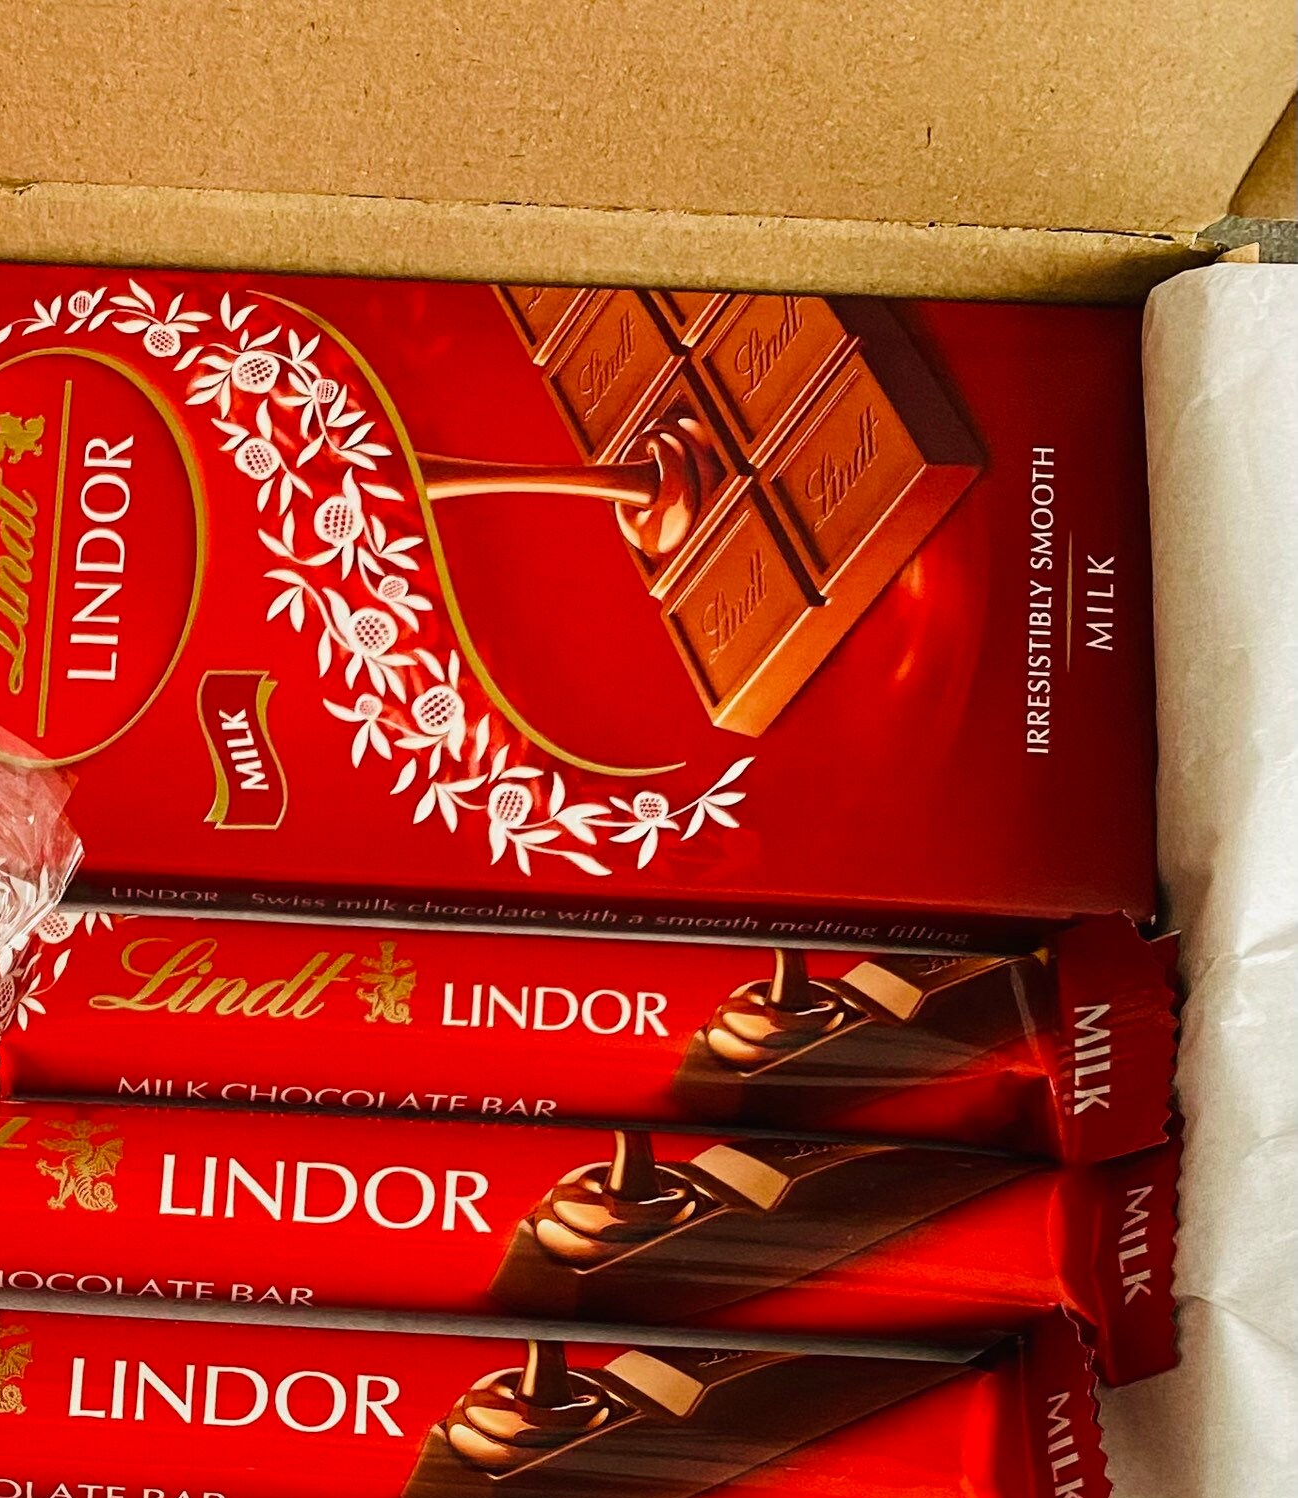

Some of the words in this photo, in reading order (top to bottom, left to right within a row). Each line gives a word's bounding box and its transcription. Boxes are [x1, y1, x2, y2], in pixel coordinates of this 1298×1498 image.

[804, 406, 880, 530] Lindt
[1030, 447, 1055, 570] SMOOTH
[67, 435, 135, 681] LINDOR
[703, 548, 769, 665] Lindt
[1086, 553, 1116, 651] MILK
[1027, 581, 1052, 754] IRRESISTIBLY
[221, 707, 270, 792] MILK
[112, 886, 218, 902] LINDOR
[251, 892, 326, 908] Swiss
[336, 893, 399, 912] milk
[407, 900, 546, 920] chocolate
[556, 908, 617, 924] with
[627, 914, 643, 925] a
[654, 915, 759, 932] smooth
[768, 919, 878, 940] melting
[886, 924, 972, 945] filling
[89, 937, 355, 1020] Lindt
[441, 982, 670, 1038] LINDOR
[117, 1076, 210, 1100] MILK
[481, 1096, 558, 1118] BAR
[1073, 1003, 1112, 1116] MILK
[159, 1153, 492, 1233] LINDOR
[230, 1282, 315, 1307] BAR
[1116, 1184, 1154, 1306] MILK
[68, 1357, 405, 1437] LINDOR
